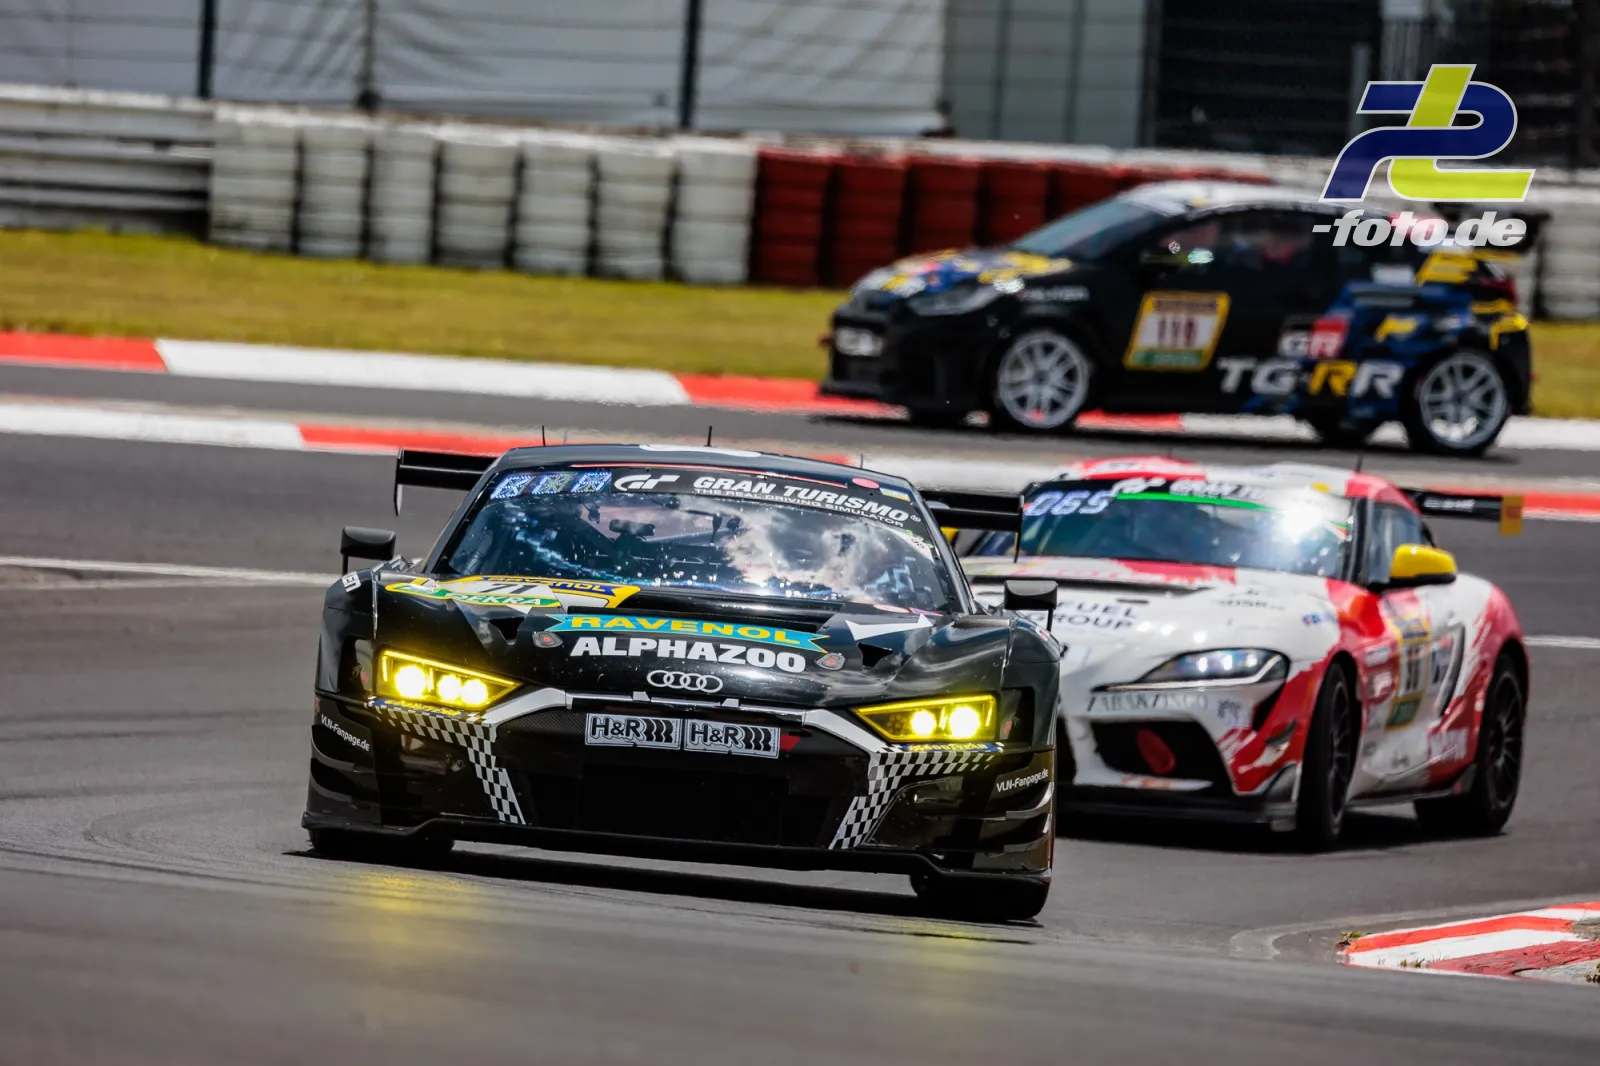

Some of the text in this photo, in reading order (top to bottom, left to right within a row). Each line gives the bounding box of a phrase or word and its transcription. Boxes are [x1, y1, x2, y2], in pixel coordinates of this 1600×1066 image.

[693, 476, 908, 521] GRAN TURISMO
[823, 502, 904, 528] SIMULATOR
[481, 583, 536, 595] 71
[571, 616, 800, 644] RAVENOL
[570, 637, 806, 673] ALPHAZOO
[321, 714, 371, 752] VLN-Fanpage.de
[996, 768, 1049, 793] VLN-Fanpage.de
